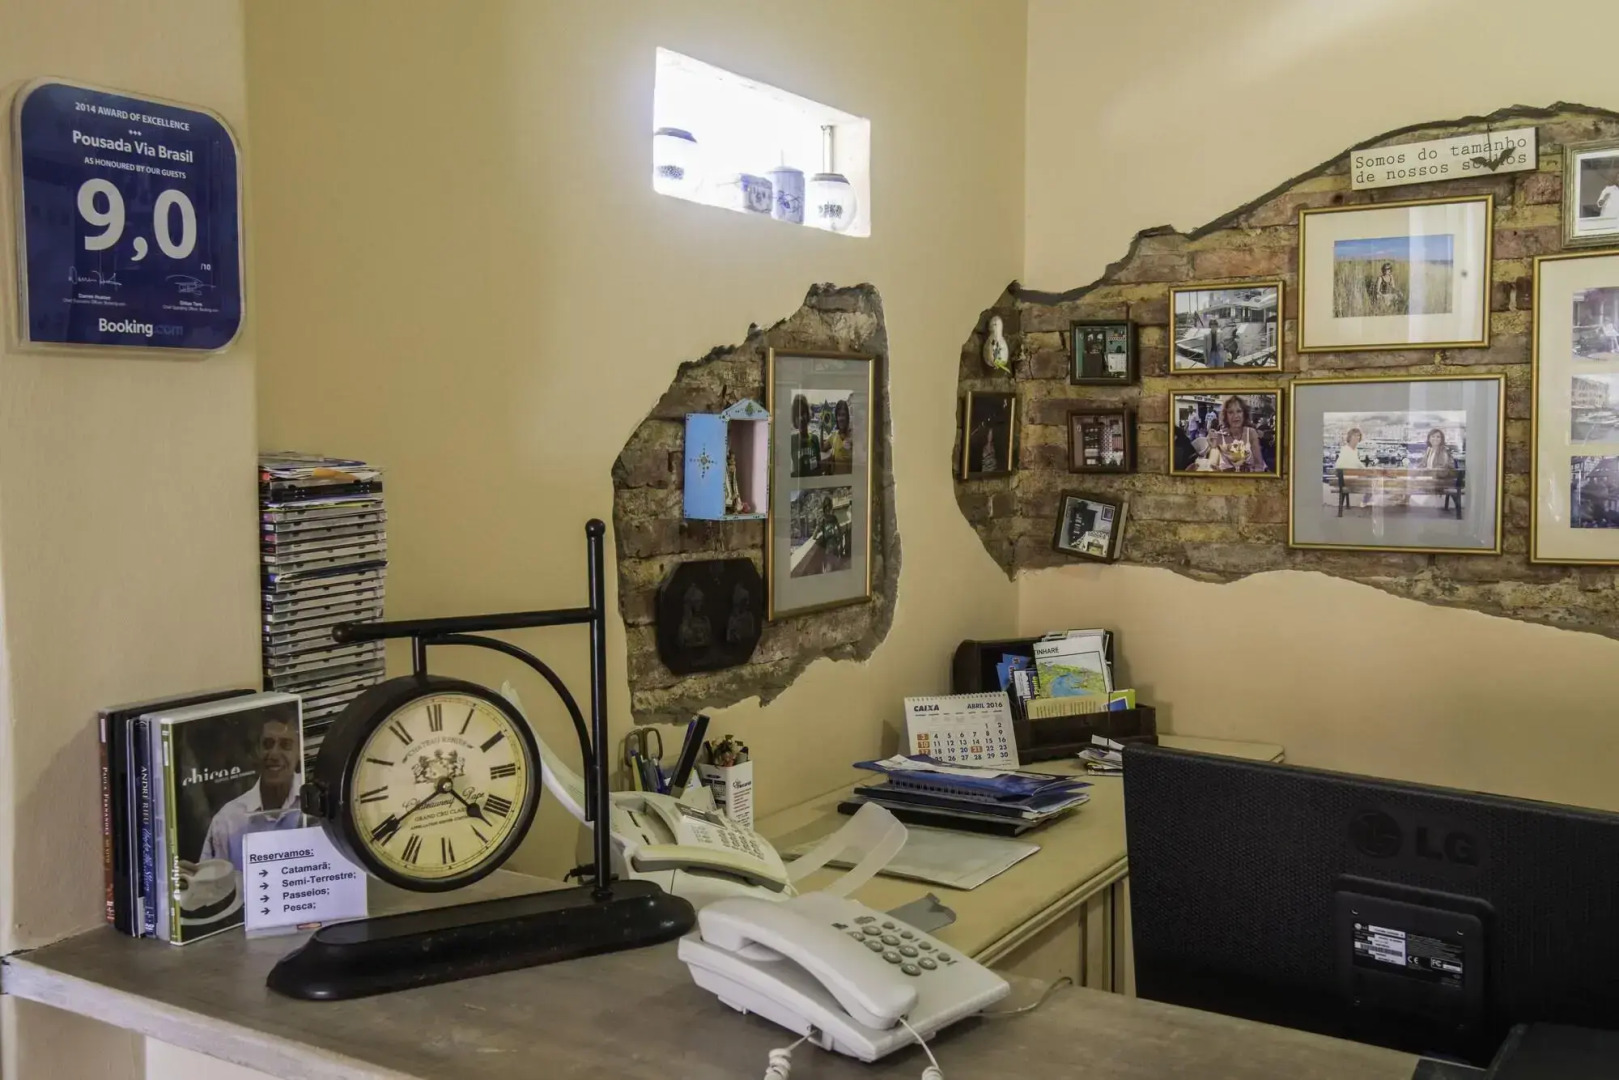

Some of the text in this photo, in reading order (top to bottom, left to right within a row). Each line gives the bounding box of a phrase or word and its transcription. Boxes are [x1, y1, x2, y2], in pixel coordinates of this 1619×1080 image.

[75, 102, 190, 131] 2014 AWARD OF EXCELLENCE
[72, 130, 193, 163] Pousada Via Brasil
[1356, 136, 1527, 169] Somos do tamanho
[95, 158, 134, 171] HONOURED
[146, 166, 160, 175] OUR
[161, 169, 186, 179] GUESTS
[1356, 152, 1527, 184] de nossos soos
[77, 178, 197, 261] 9,0
[415, 813, 436, 822] GRAND
[249, 848, 314, 863] Reservamos:
[1416, 826, 1480, 868] LG
[281, 862, 330, 875] Catamarã;
[282, 872, 356, 887] Semi-Terrestre;
[283, 888, 330, 900] Passeios;
[283, 902, 316, 912] Pesca;
